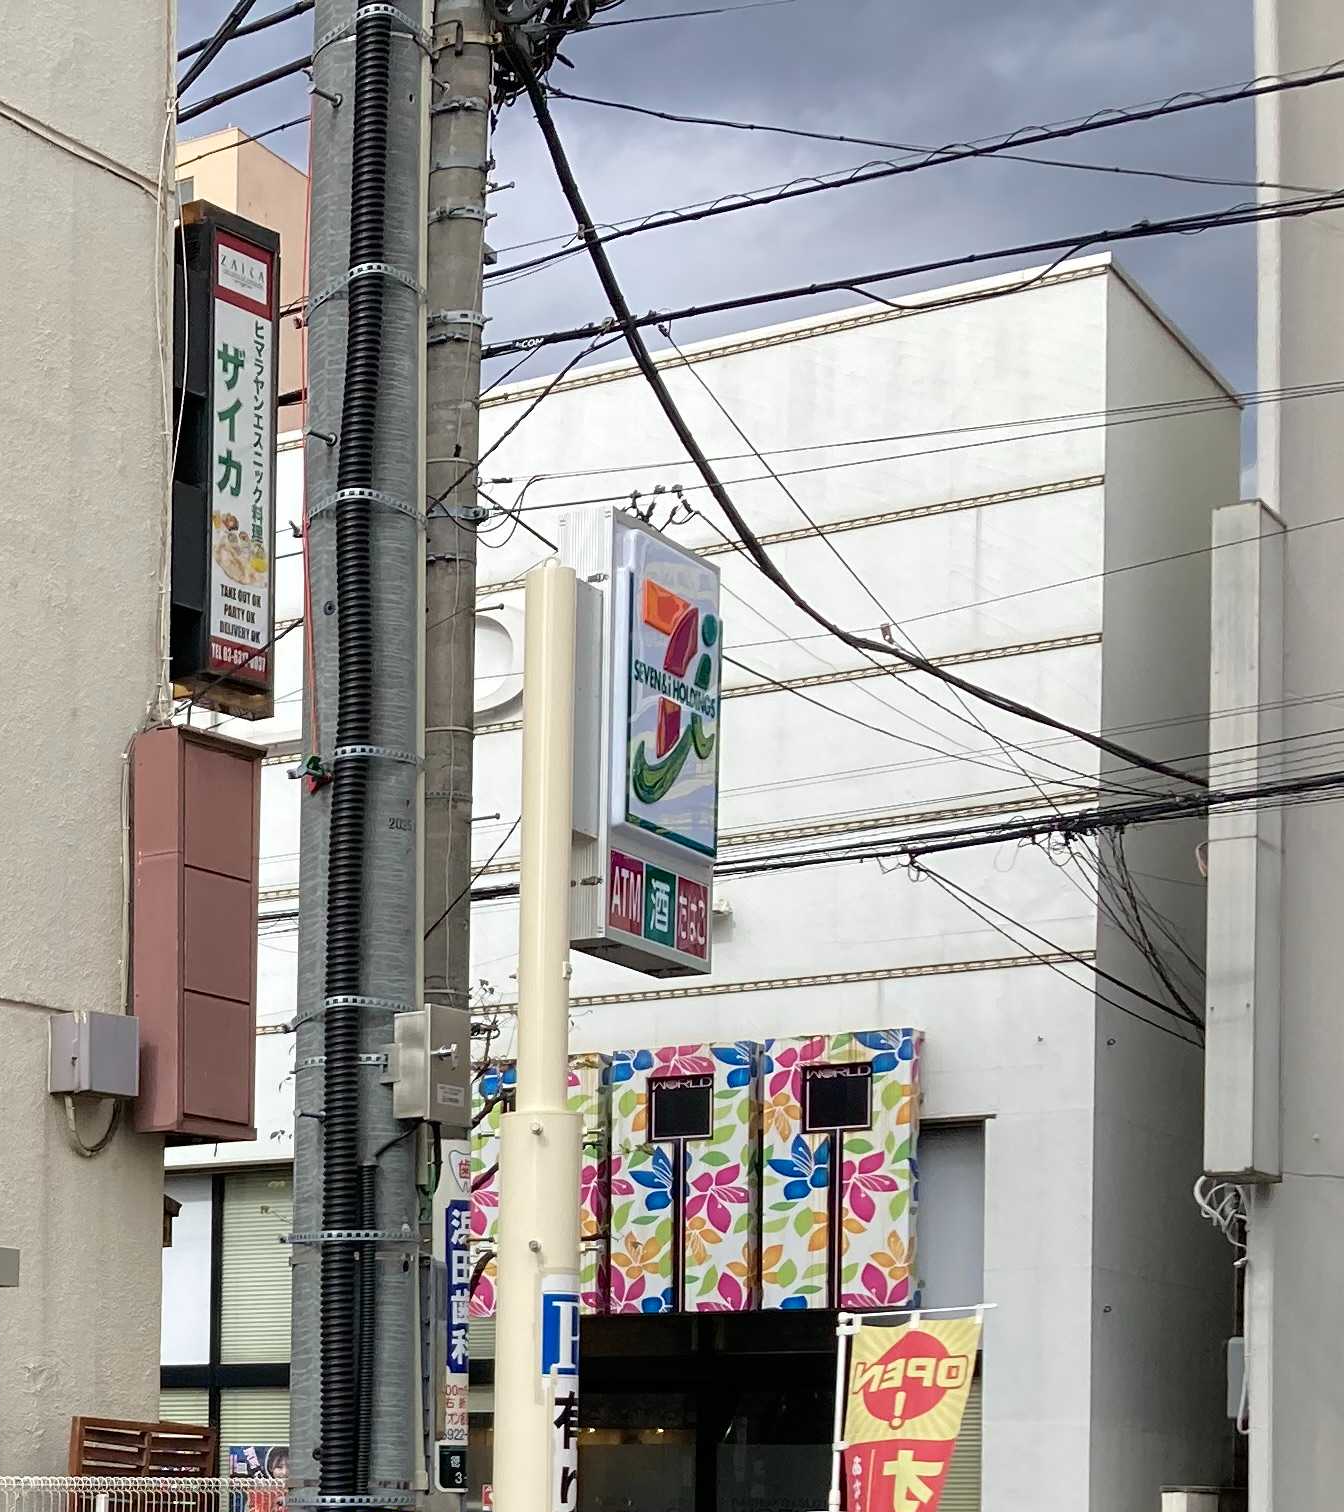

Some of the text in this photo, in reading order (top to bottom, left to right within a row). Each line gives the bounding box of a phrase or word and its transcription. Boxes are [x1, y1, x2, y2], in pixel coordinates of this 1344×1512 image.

[216, 342, 246, 497] ザイカ
[238, 588, 251, 604] OUT
[252, 593, 261, 608] OK
[224, 603, 256, 624] PARTY OK
[219, 620, 261, 644] DELIVERY OK
[211, 642, 222, 660] TEL
[672, 680, 716, 719] HOLDINGS
[612, 866, 641, 923] ATM
[650, 878, 670, 933] 酒
[806, 1066, 871, 1079] WORLD
[652, 1077, 712, 1091] WORLD
